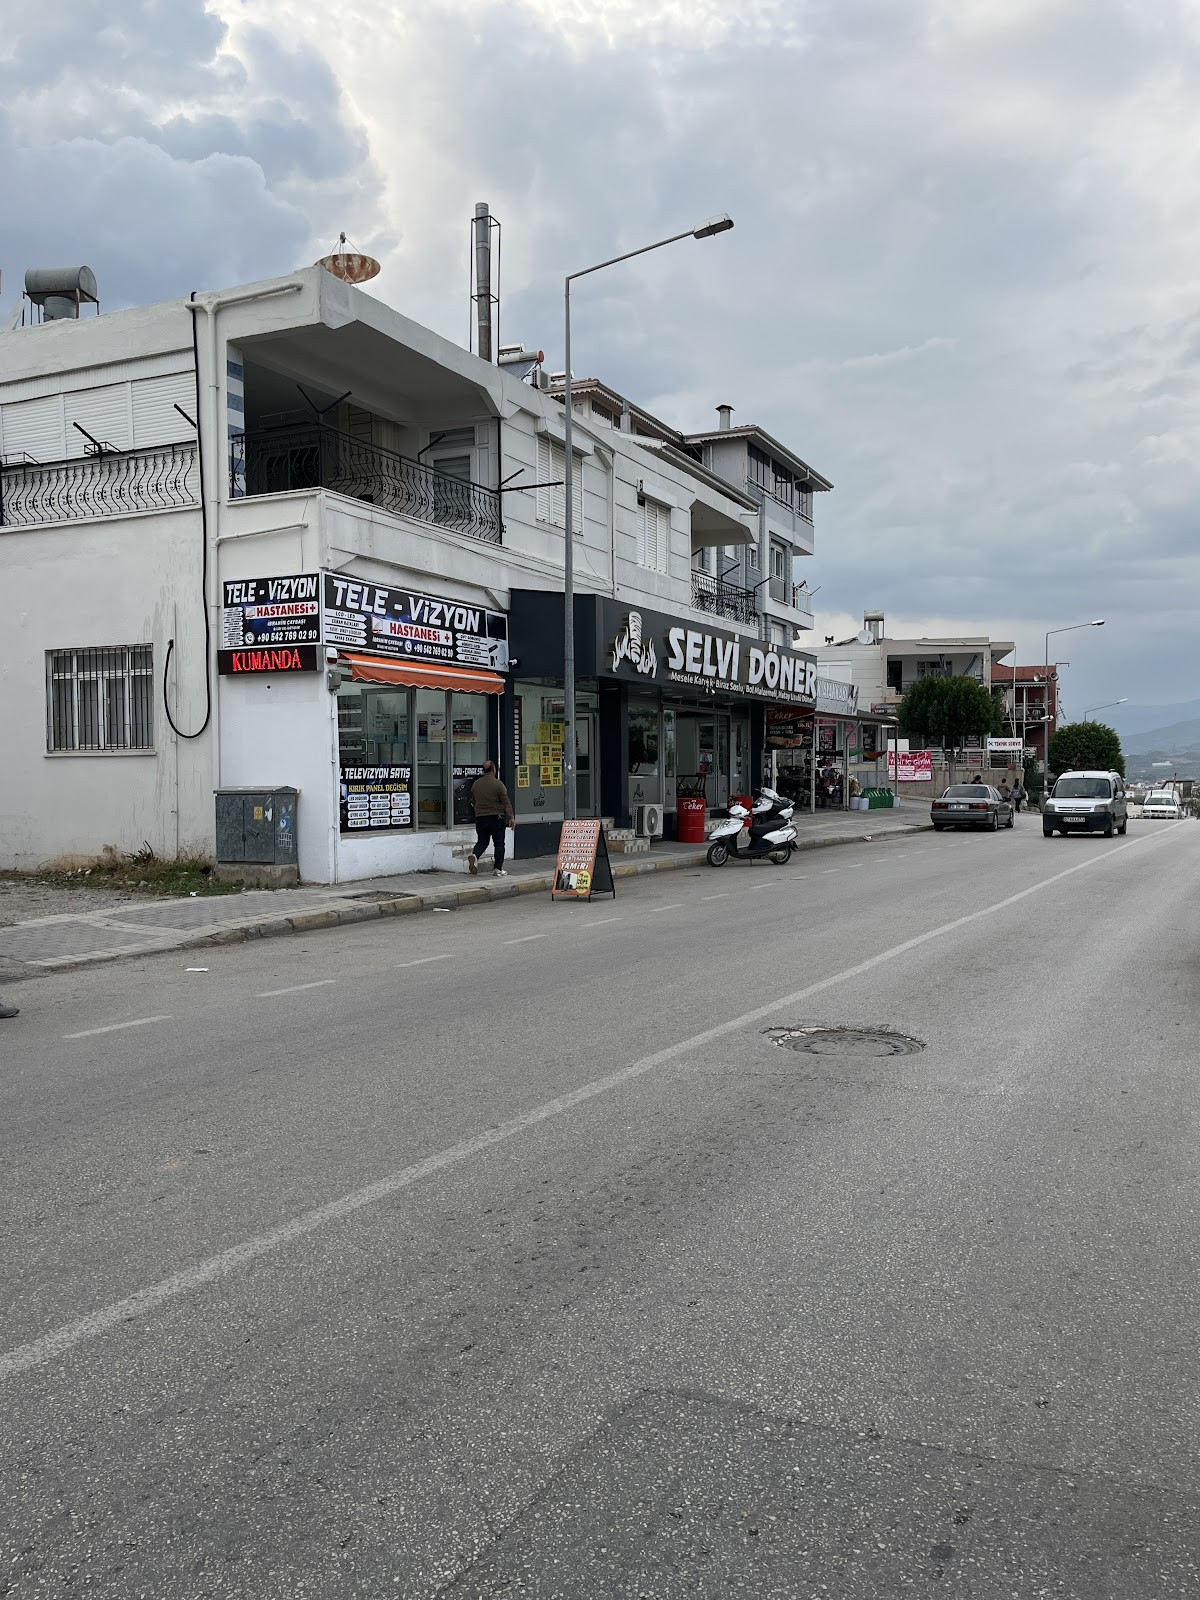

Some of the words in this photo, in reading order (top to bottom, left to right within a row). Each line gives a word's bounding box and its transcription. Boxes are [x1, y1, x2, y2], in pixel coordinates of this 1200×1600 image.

[226, 582, 256, 604] TELE
[332, 579, 389, 615] TELE
[258, 632, 270, 642] +90
[271, 632, 283, 641] 542
[285, 631, 297, 640] 769
[298, 630, 307, 640] 02
[308, 630, 317, 640] 90
[232, 649, 302, 671] KUMANDA
[414, 644, 423, 653] +90
[423, 645, 432, 654] 542
[441, 648, 448, 657] 02
[448, 649, 453, 658] 90
[668, 627, 740, 681] SELVİ
[750, 644, 817, 699] DÖNER
[671, 671, 693, 684] Mesele
[716, 680, 729, 690] Biraz
[390, 768, 410, 782] SATIŞ
